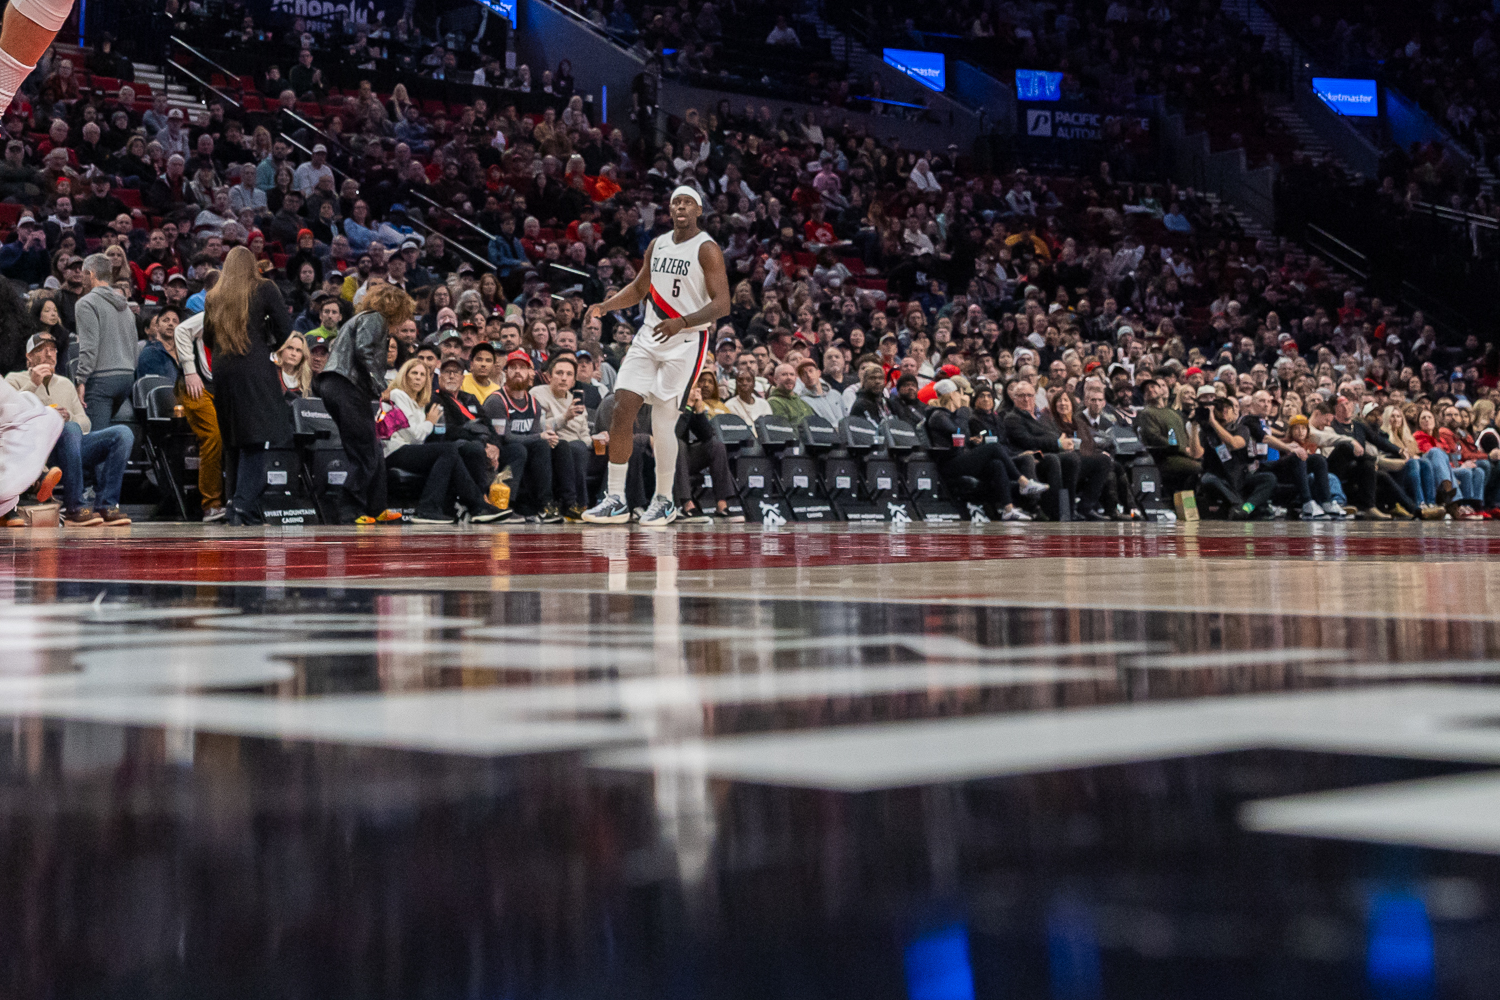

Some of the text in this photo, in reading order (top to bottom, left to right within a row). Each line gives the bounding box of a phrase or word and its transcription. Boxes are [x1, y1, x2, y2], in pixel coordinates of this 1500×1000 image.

[1318, 91, 1373, 103] ketmaster
[651, 257, 691, 276] BLAZERS
[672, 279, 681, 298] 5
